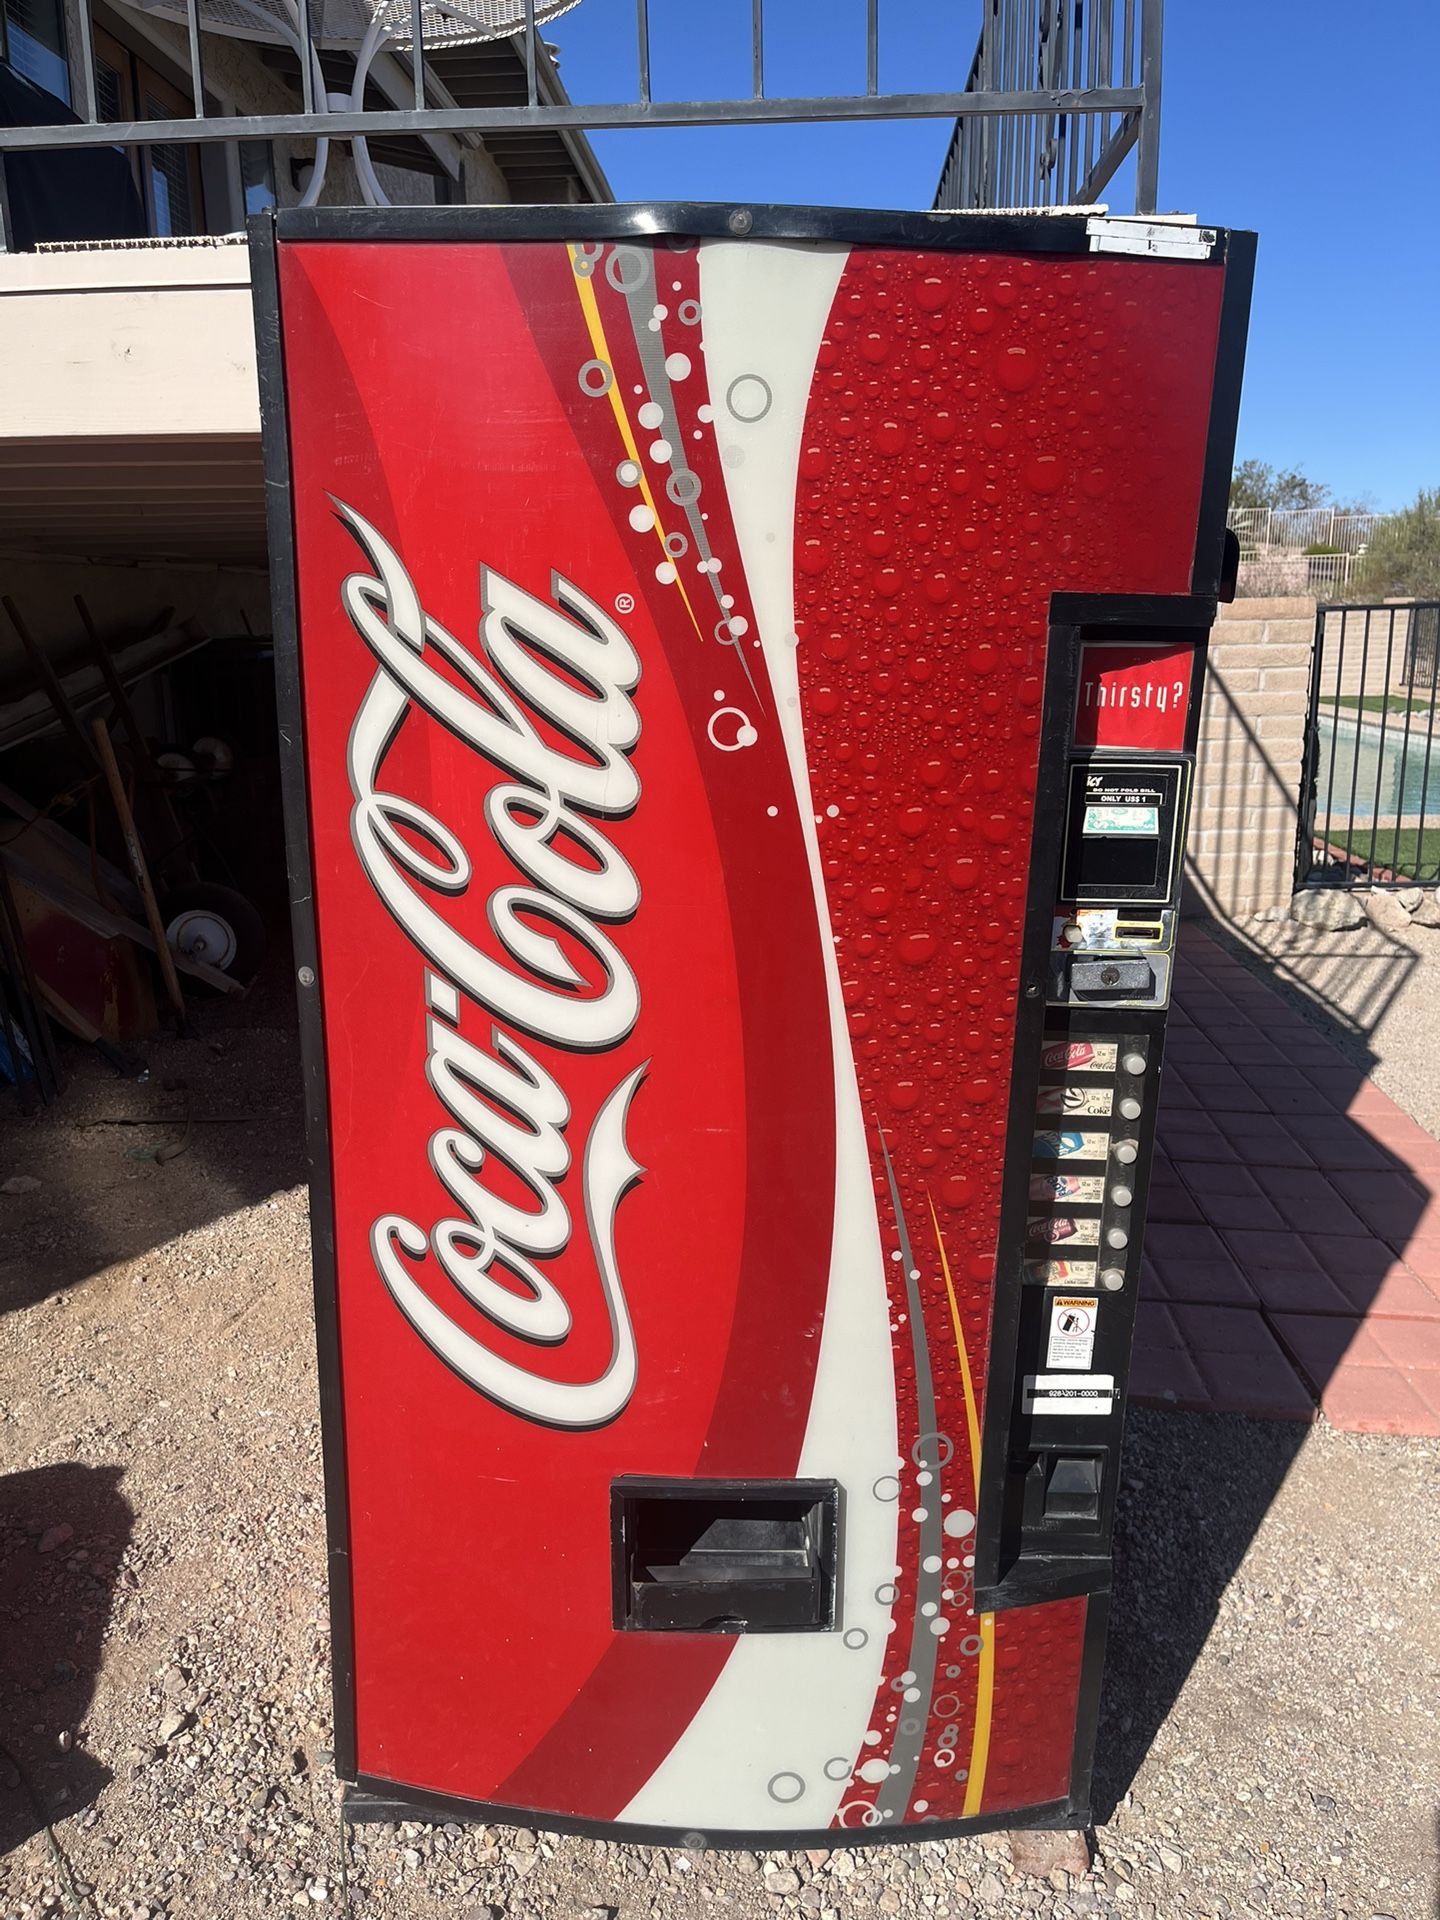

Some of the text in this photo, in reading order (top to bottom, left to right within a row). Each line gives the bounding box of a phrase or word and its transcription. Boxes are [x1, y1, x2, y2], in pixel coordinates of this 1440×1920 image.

[1085, 681, 1183, 713] Thirsty?
[323, 490, 649, 1433] Coca-Cola
[1087, 1106, 1110, 1114] Coke
